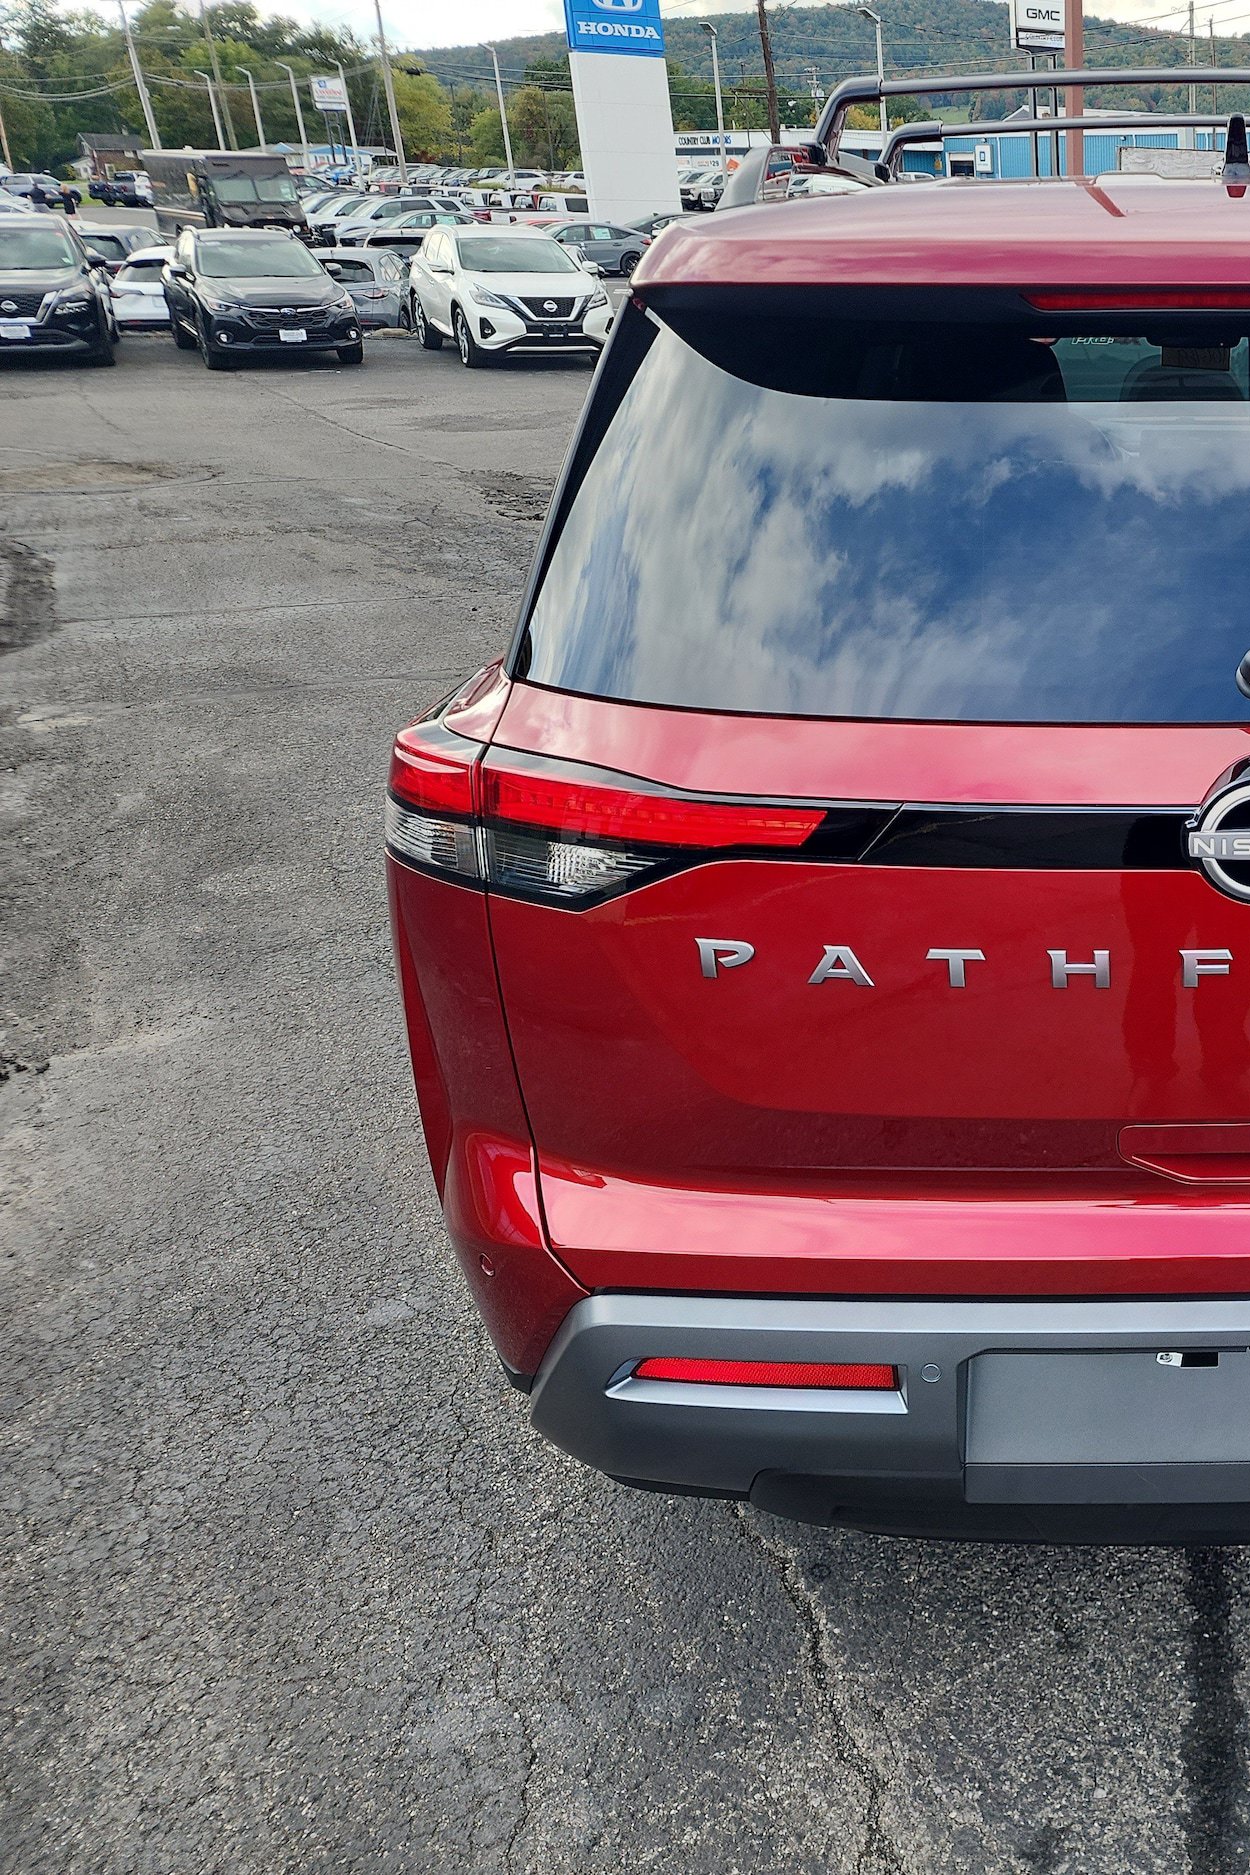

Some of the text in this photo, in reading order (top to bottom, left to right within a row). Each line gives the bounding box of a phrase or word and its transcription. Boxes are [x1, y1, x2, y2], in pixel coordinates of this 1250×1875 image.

[1026, 8, 1060, 21] GMC
[577, 21, 661, 39] HONDA
[678, 137, 699, 145] COUNTRY
[700, 136, 711, 145] CLUB
